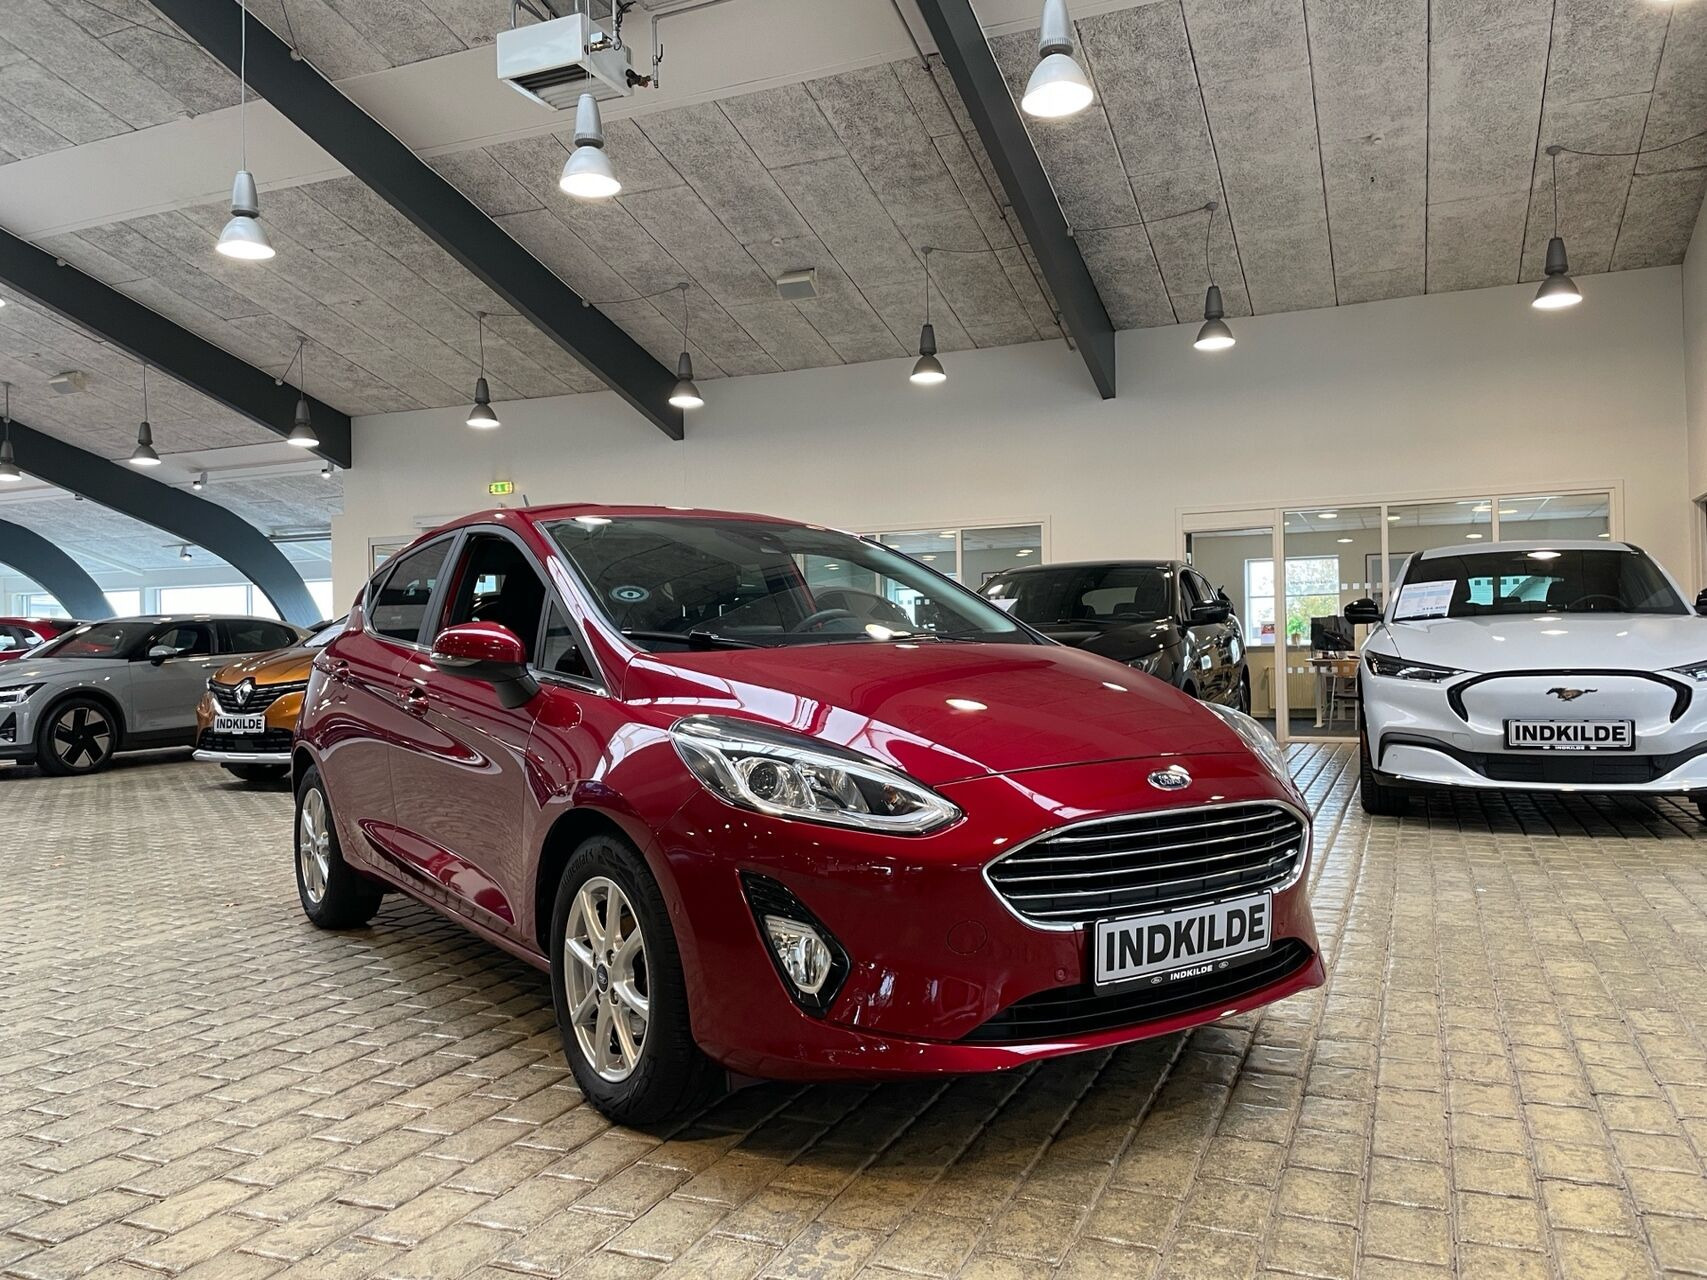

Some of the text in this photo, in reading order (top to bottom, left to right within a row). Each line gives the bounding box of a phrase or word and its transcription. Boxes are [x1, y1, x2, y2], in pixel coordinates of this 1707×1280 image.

[216, 718, 263, 730] INDKILDE
[1515, 725, 1626, 742] INDKILDE
[1106, 903, 1265, 972] INDKILDE
[1170, 964, 1213, 981] INDKILDE
